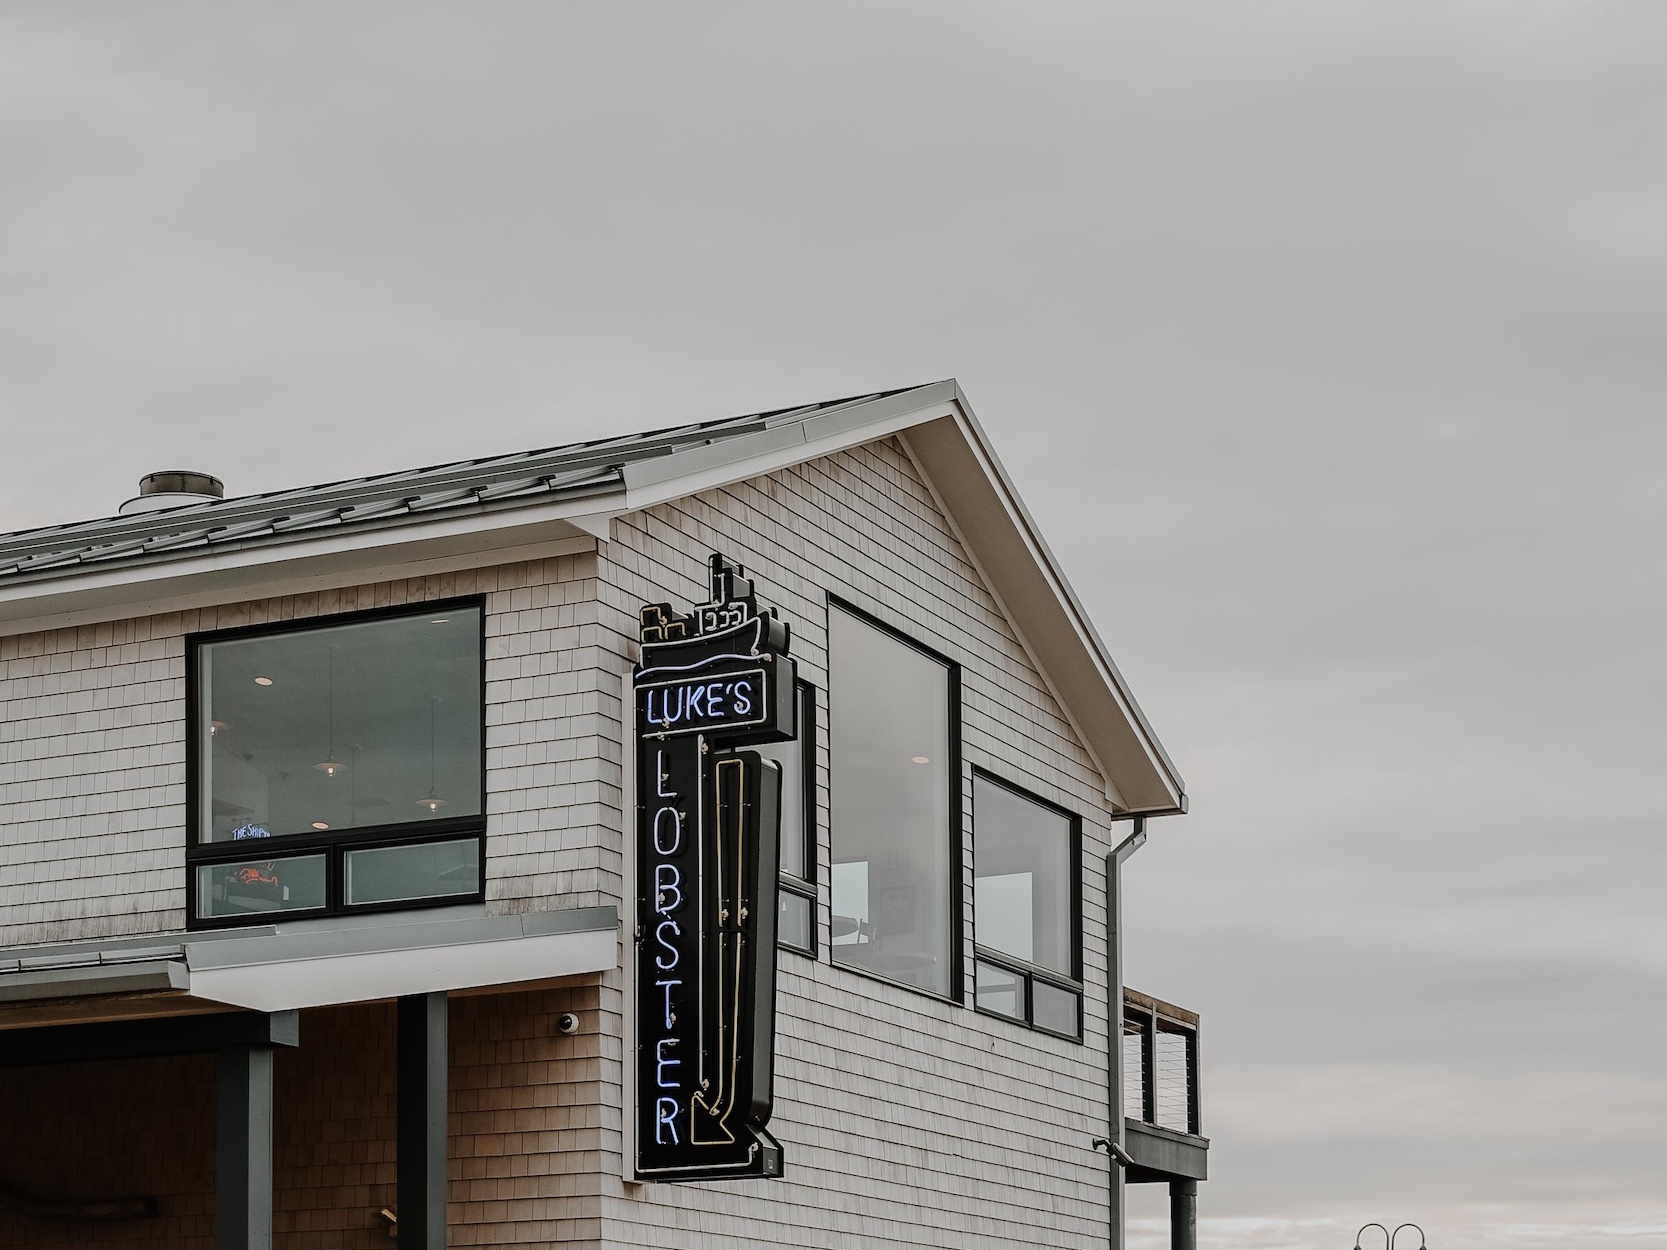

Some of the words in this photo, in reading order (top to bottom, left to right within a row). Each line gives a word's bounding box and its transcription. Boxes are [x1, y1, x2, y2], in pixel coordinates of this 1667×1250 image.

[647, 681, 752, 725] LUKE'S
[232, 826, 246, 840] THE
[653, 750, 681, 1145] LOBSTER
